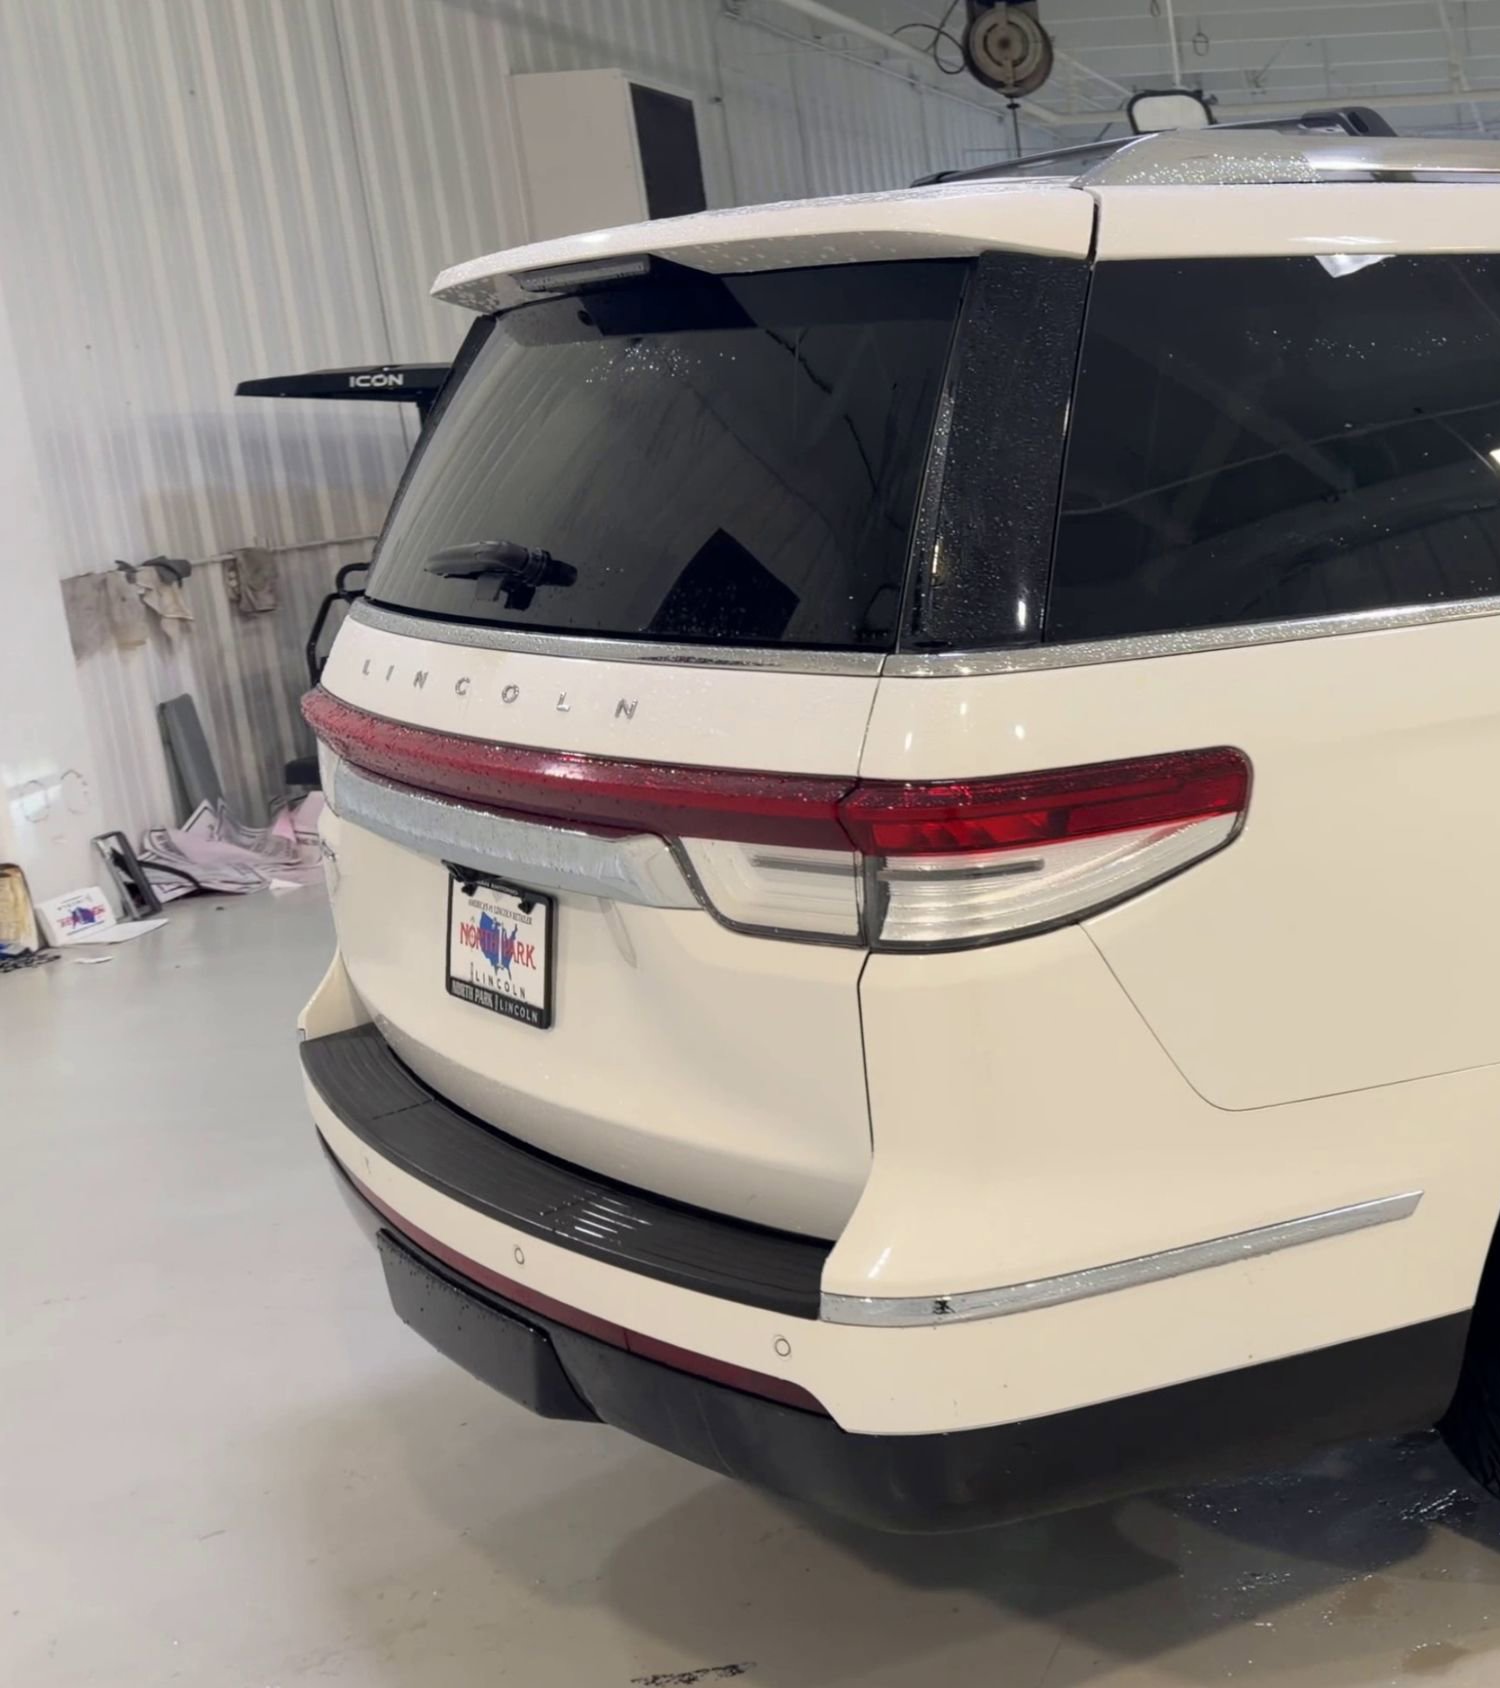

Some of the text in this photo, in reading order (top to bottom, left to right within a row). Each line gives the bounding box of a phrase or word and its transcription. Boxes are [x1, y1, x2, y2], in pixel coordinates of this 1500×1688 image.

[349, 373, 404, 388] ICON
[362, 658, 638, 721] LINCOLN
[460, 921, 537, 970] NORTH PARK
[475, 968, 526, 999] LINCOLN
[474, 986, 494, 1009] PARK
[499, 993, 538, 1023] LINCOLN
